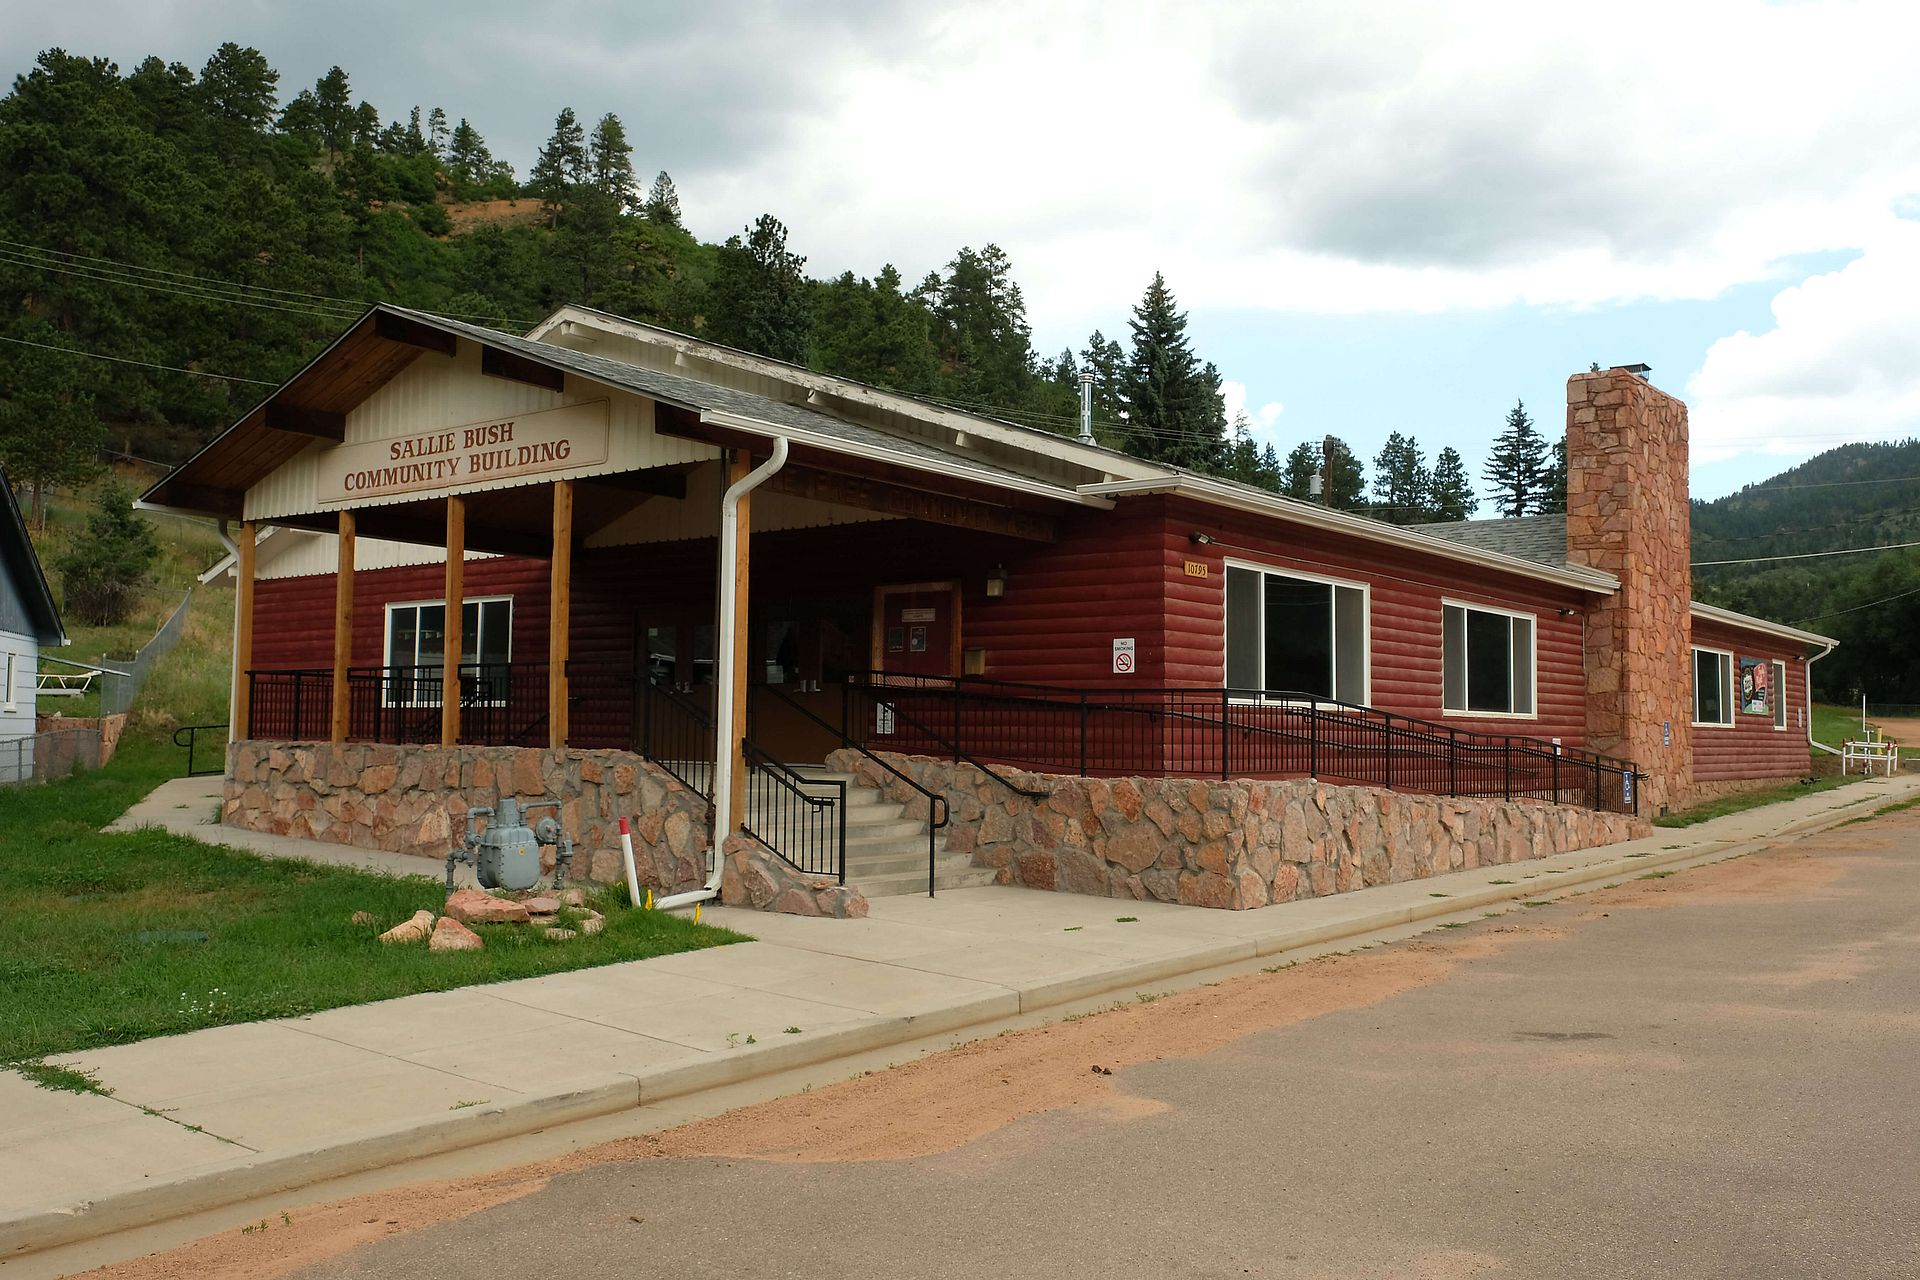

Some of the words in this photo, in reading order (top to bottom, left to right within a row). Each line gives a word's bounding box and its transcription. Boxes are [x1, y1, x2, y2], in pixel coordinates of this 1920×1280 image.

[390, 432, 456, 461] SALLIE
[463, 422, 515, 449] BUSH
[344, 456, 461, 491] COMMUNITY
[468, 439, 571, 474] BUILDING
[1188, 563, 1206, 576] 10795
